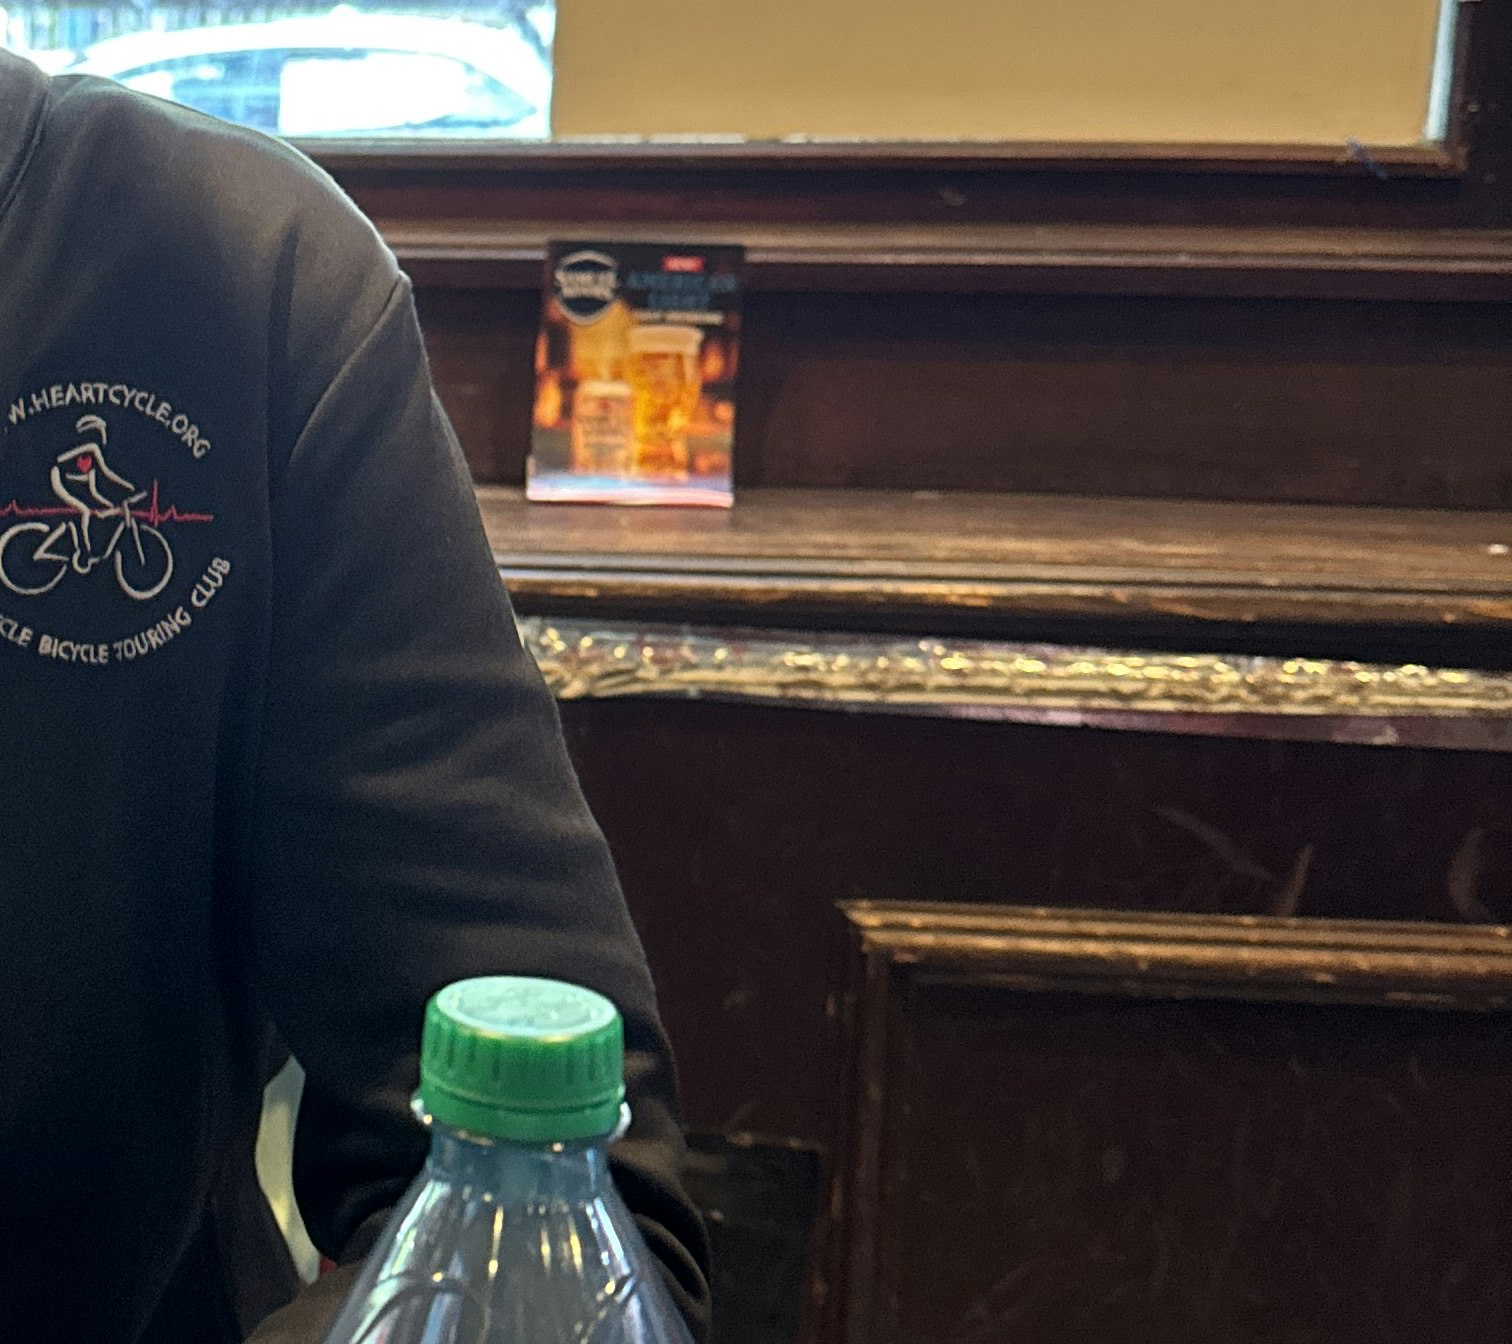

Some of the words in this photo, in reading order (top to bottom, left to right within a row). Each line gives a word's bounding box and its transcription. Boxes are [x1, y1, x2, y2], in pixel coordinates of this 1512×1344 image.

[38, 634, 109, 665] BICYCLE
[113, 605, 193, 663] TOURING
[191, 557, 232, 608] CLUB
